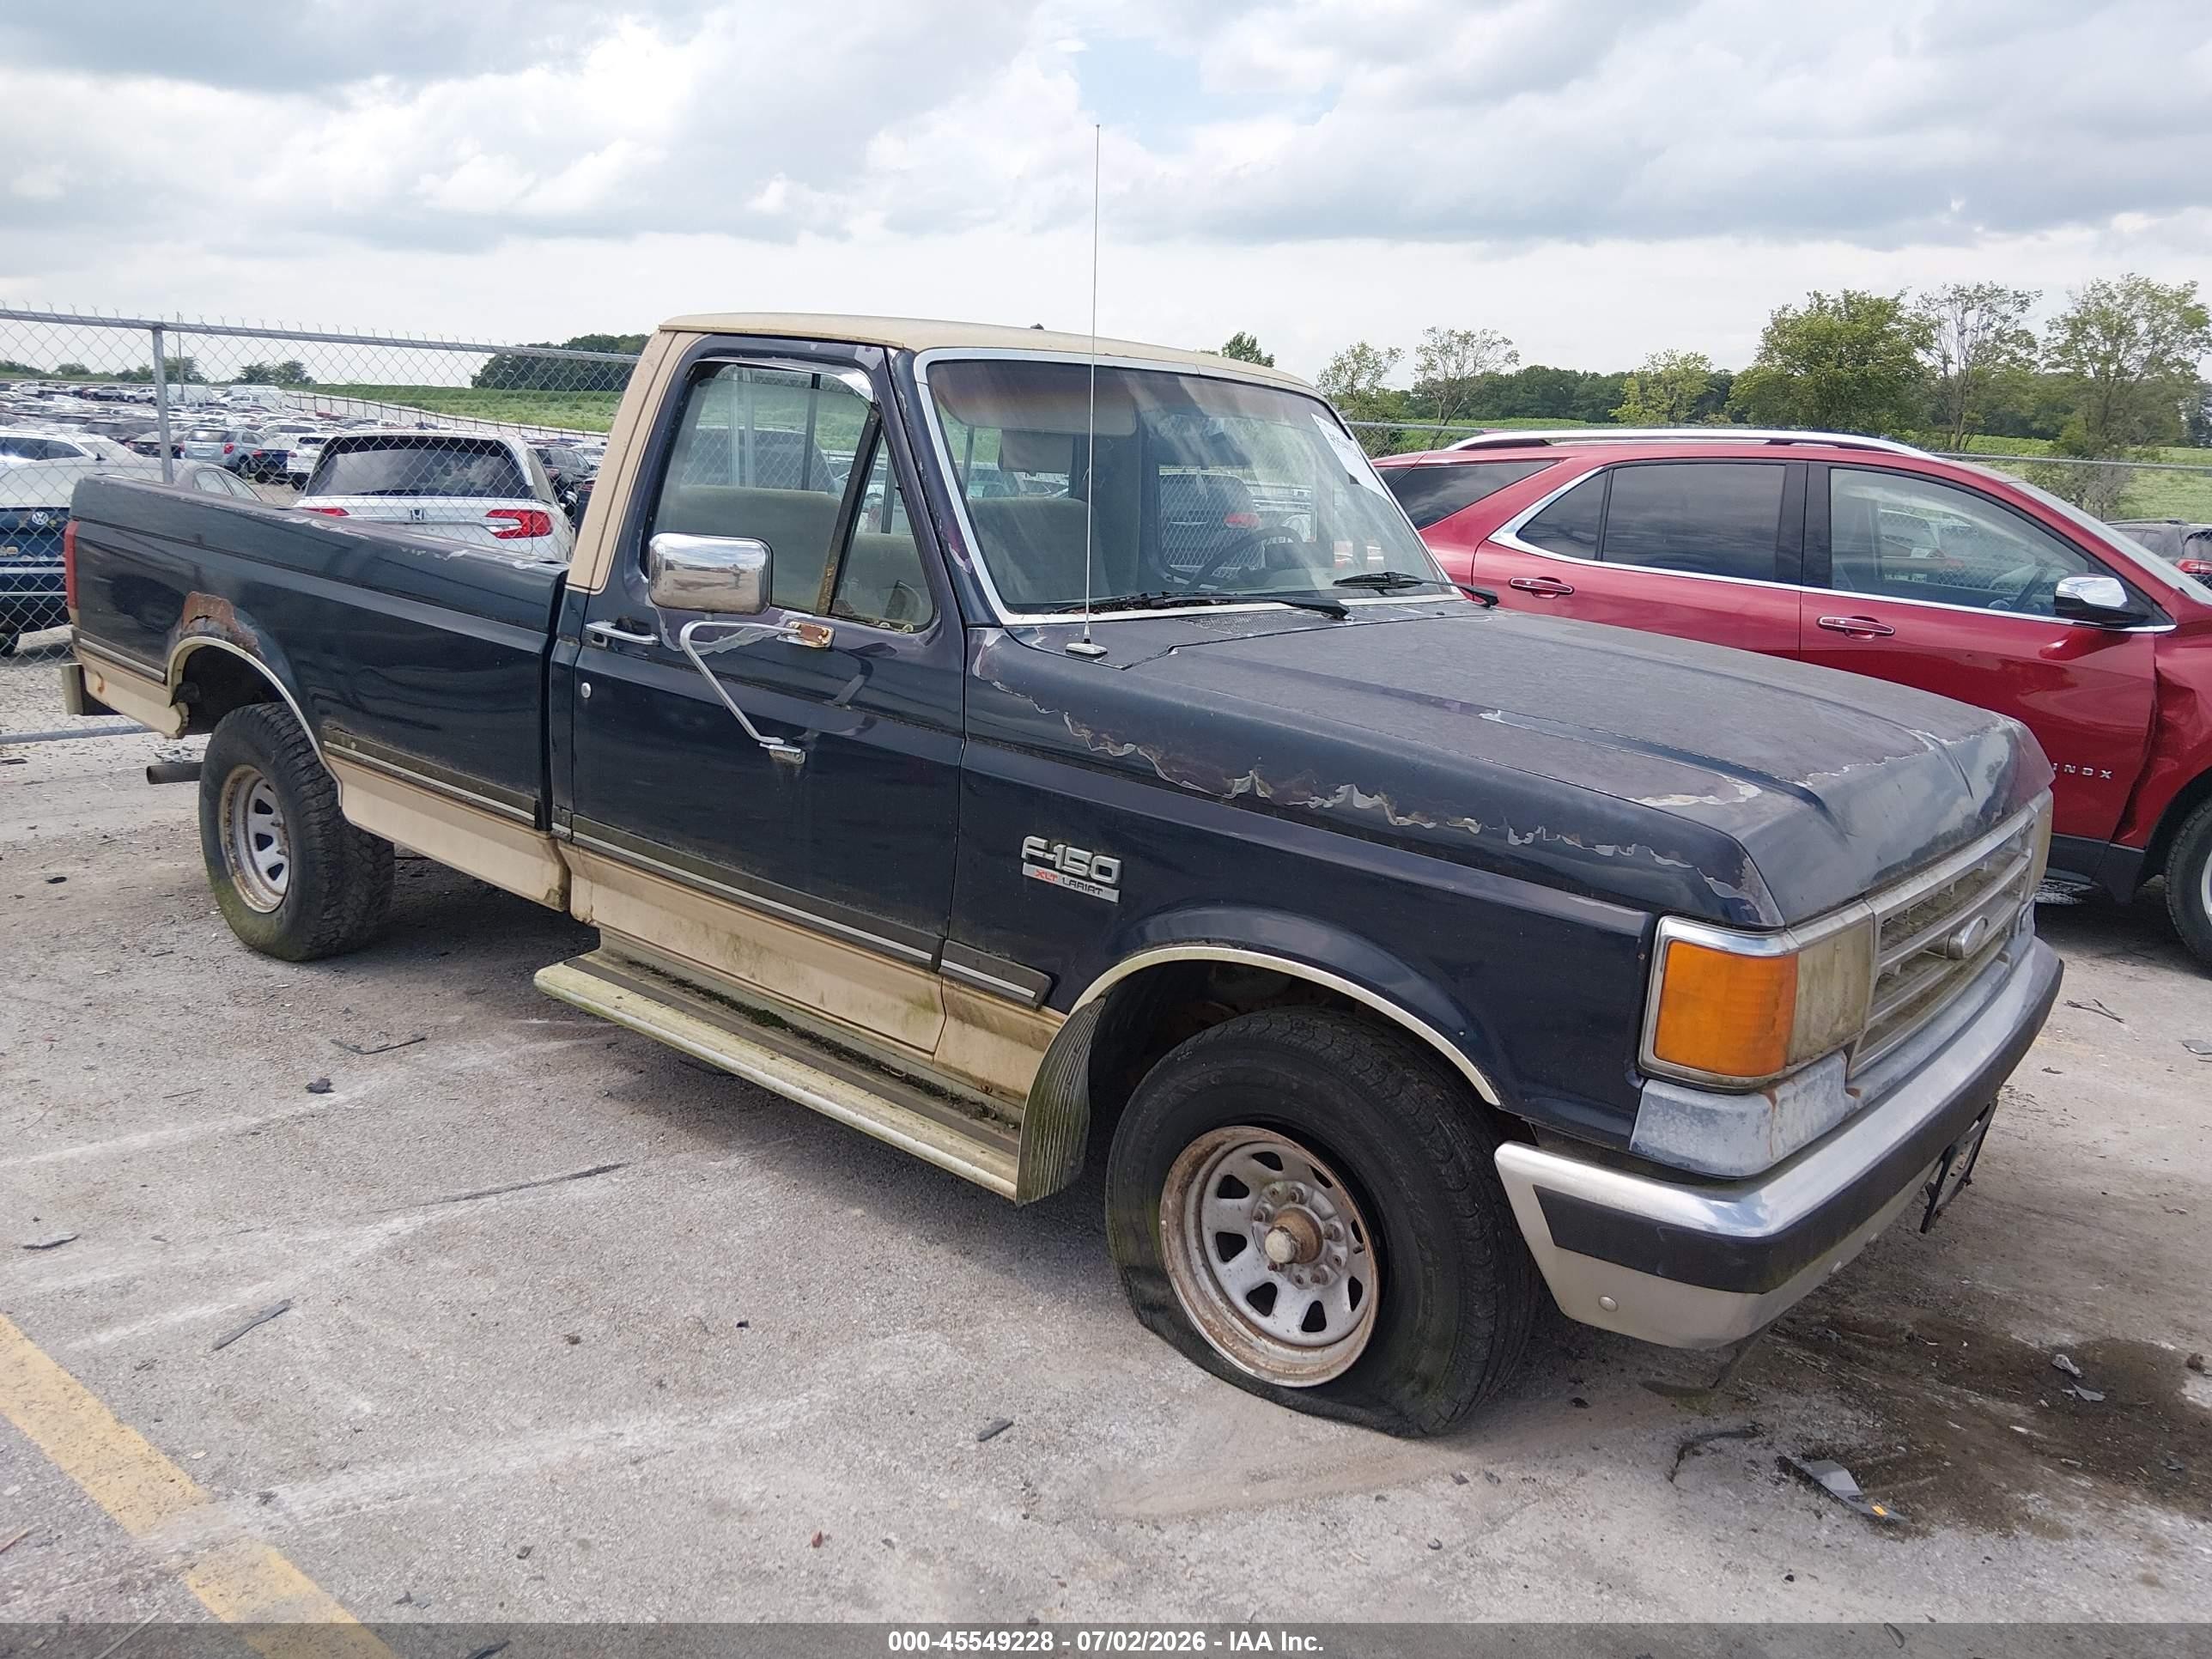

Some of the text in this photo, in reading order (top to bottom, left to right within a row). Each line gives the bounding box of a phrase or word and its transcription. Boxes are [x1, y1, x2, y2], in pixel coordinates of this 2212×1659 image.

[1020, 835, 1122, 884] F-150
[1034, 868, 1103, 896] XLT LARIAT
